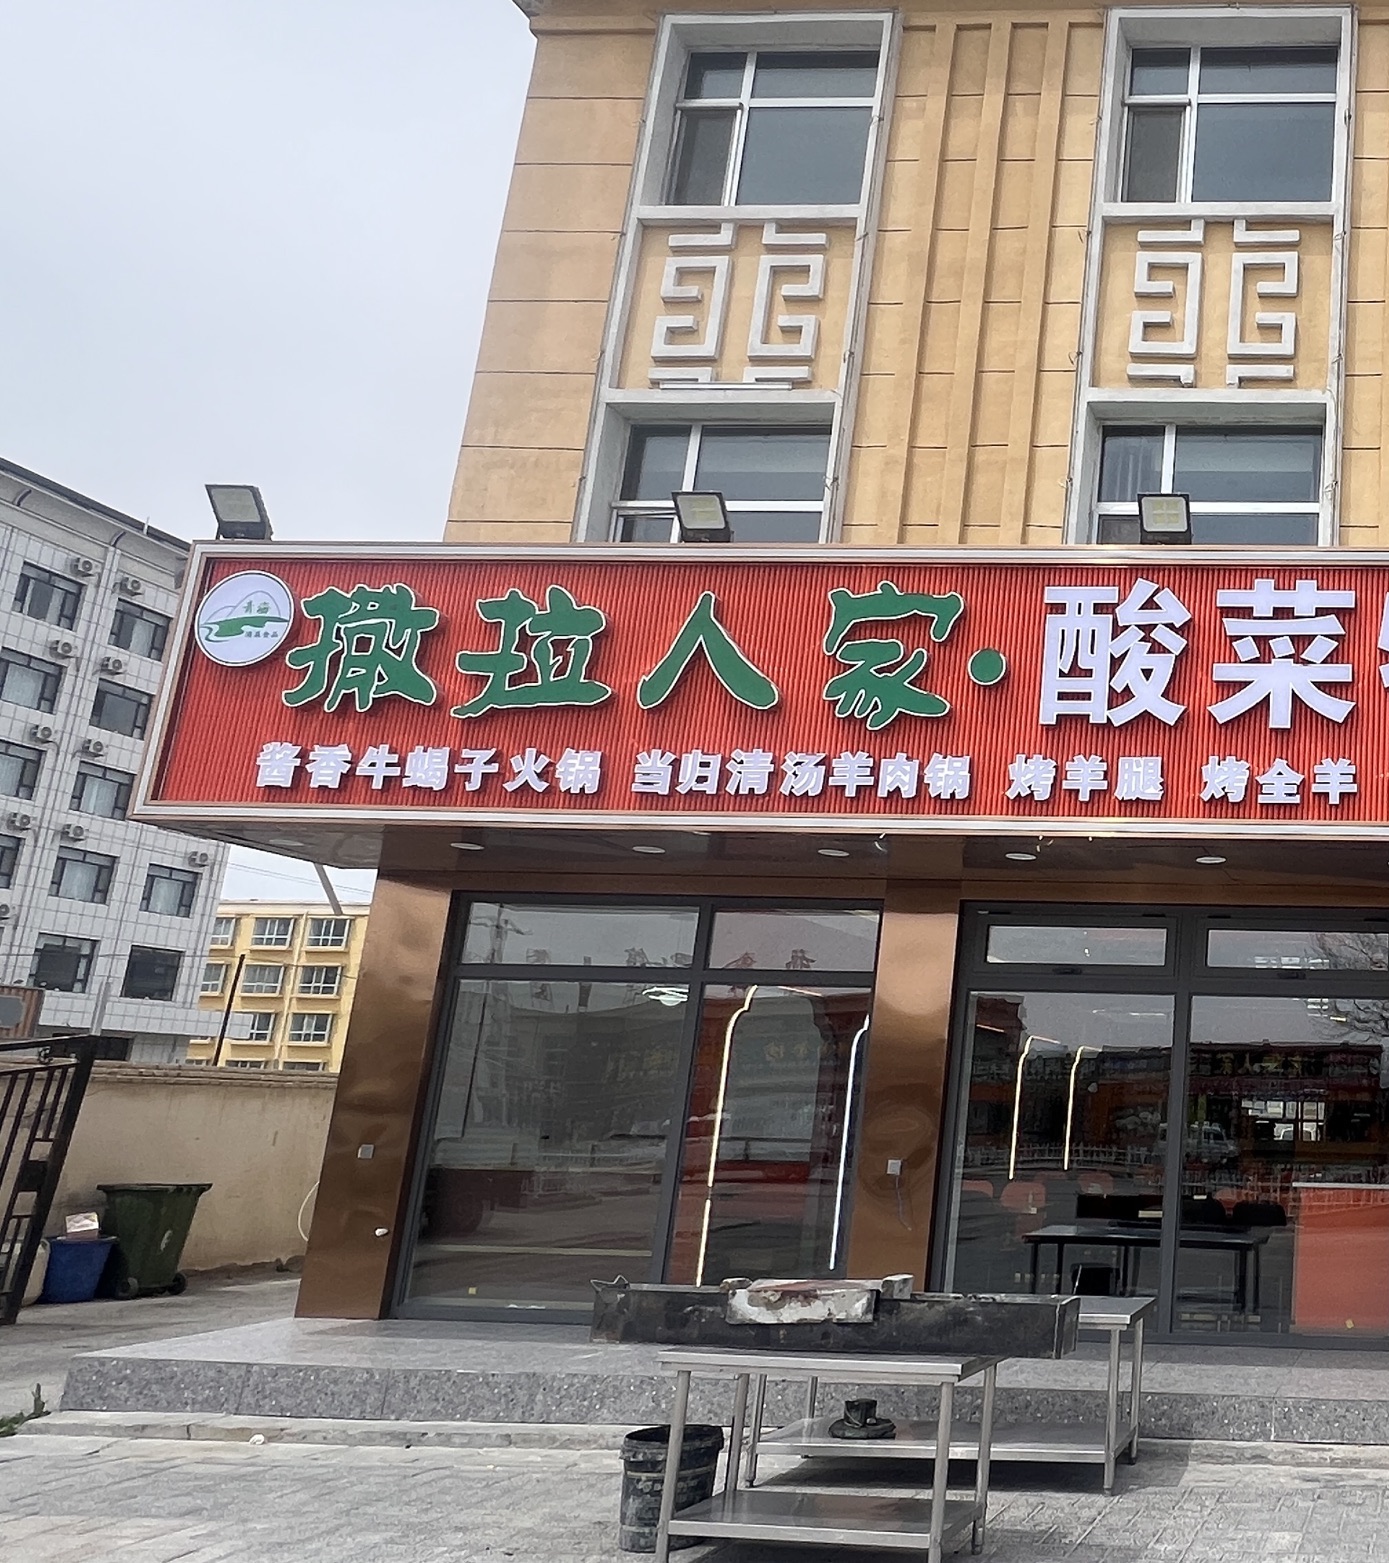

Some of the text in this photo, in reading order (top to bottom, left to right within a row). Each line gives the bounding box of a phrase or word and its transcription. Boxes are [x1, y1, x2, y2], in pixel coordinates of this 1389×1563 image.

[255, 741, 603, 795] 酱香牛蝎子火锅
[631, 747, 973, 801] 当归清汤羊肉锅
[1005, 753, 1165, 803] 烤羊腿
[1199, 754, 1359, 806] 烤全羊
